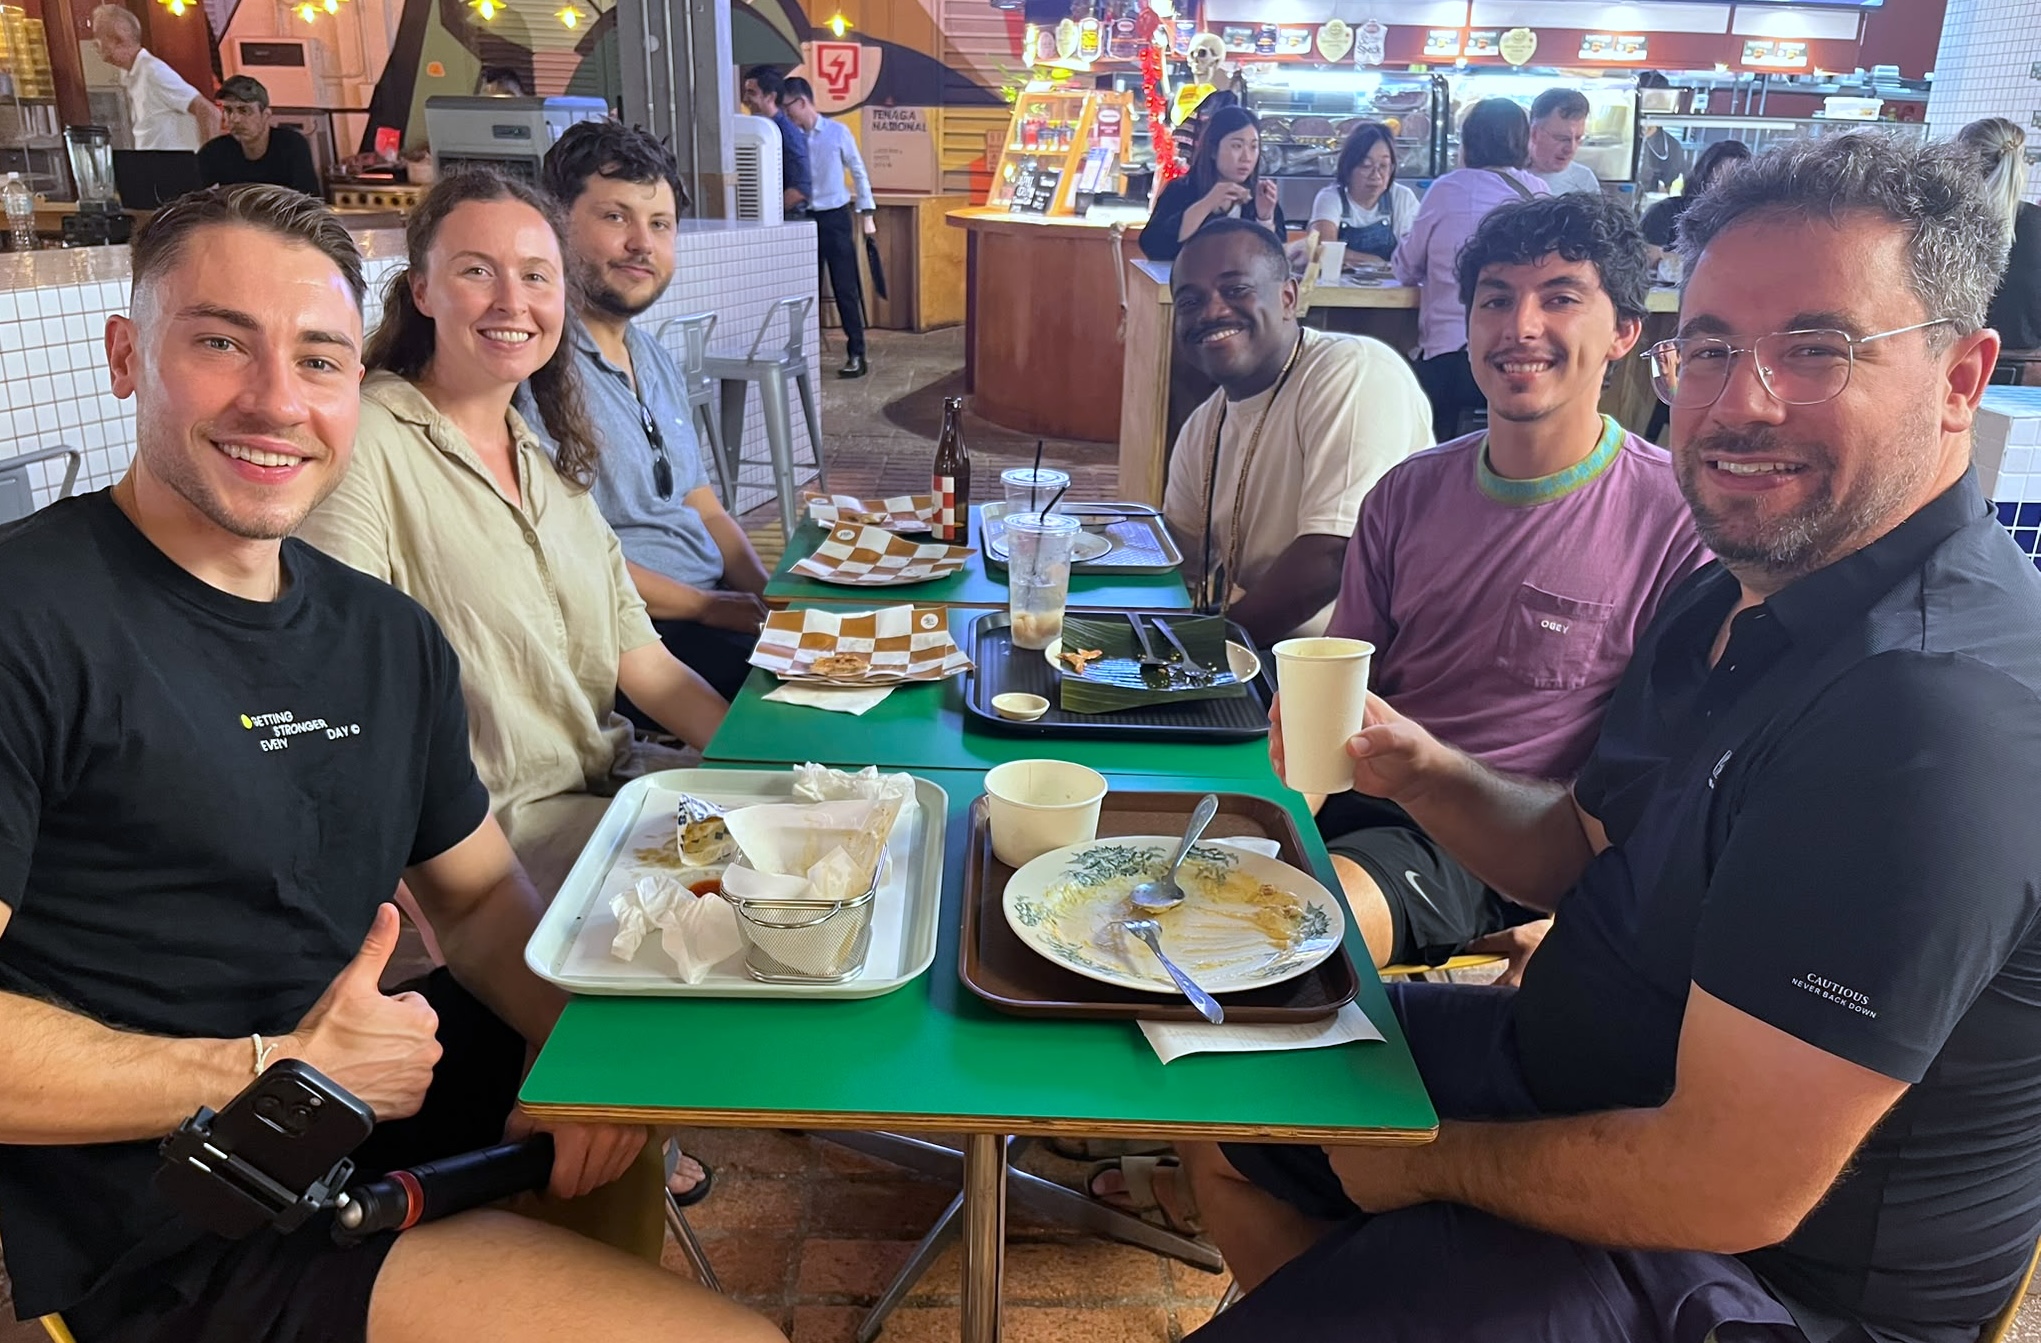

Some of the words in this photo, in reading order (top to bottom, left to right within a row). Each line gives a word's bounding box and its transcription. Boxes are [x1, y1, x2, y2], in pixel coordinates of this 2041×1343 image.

[873, 109, 916, 120] TENAGA
[872, 121, 927, 132] NASIONAL
[1540, 619, 1569, 634] OBEY
[273, 718, 328, 738] STRONGER
[326, 725, 349, 740] DAY
[1807, 972, 1870, 1005] CAUTIOUS
[1791, 978, 1821, 996] NEVER
[1822, 991, 1847, 1007] BACK
[1848, 1003, 1877, 1019] DOWN
